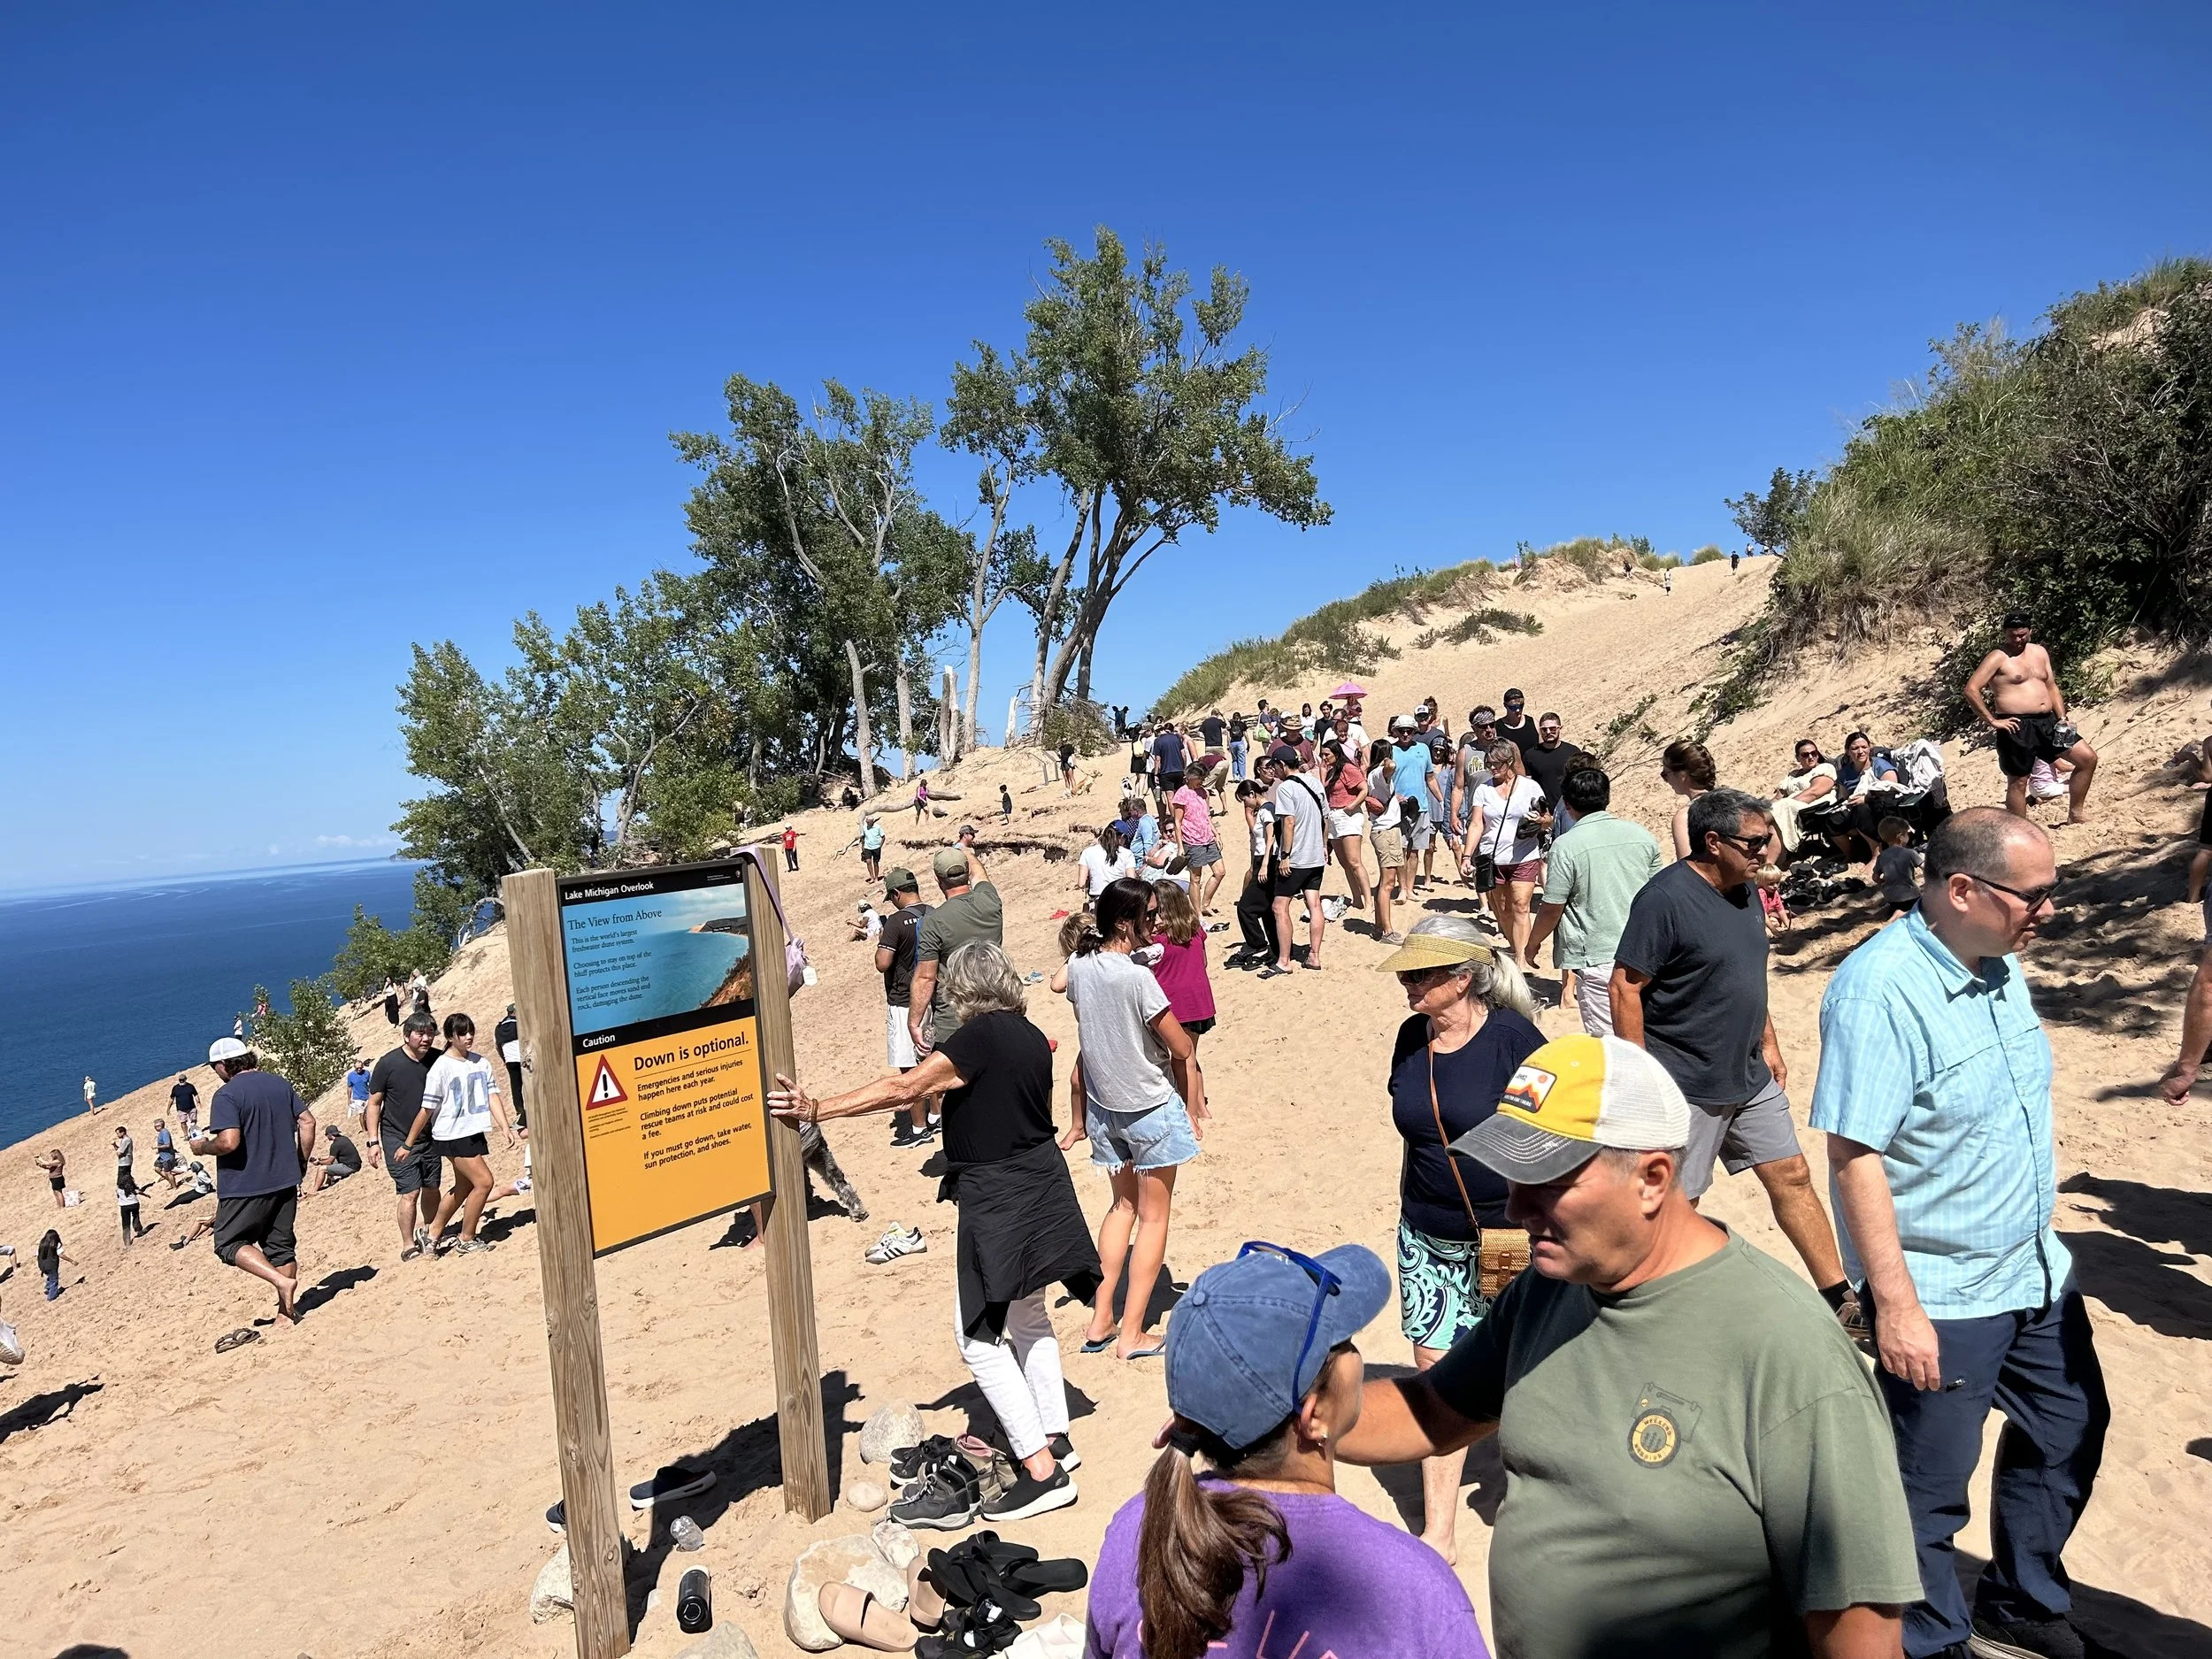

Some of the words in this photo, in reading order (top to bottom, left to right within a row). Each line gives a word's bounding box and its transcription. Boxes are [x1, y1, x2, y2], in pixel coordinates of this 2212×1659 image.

[565, 890, 583, 900] Lake
[585, 887, 618, 897] Michigan
[620, 881, 654, 893] Overlook
[567, 919, 586, 930] The
[588, 917, 611, 926] View
[612, 914, 634, 924] from
[635, 910, 662, 920] Above
[573, 960, 600, 969] Choosing
[588, 966, 611, 977] protects
[622, 962, 637, 971] place.
[590, 983, 609, 992] person
[610, 978, 641, 987] descending
[592, 997, 618, 1007] damaging
[582, 1034, 616, 1048] Caution
[634, 1051, 675, 1071] Down
[679, 1046, 689, 1060] is
[693, 1031, 749, 1058] optional.
[637, 1074, 680, 1092] Emergencies
[681, 1070, 695, 1080] and
[695, 1064, 718, 1077] serious
[720, 1059, 743, 1071] injuries
[448, 1071, 489, 1119] 10
[638, 1088, 664, 1101] happen
[665, 1082, 681, 1094] here
[683, 1079, 698, 1090] each
[700, 1076, 715, 1087] year.
[640, 1108, 671, 1121] Climbing
[672, 1102, 692, 1112] down
[694, 1096, 708, 1108] puts
[709, 1087, 738, 1103] potential
[641, 1119, 663, 1131] rescue
[664, 1112, 686, 1124] teams
[695, 1106, 708, 1116] risk
[709, 1102, 721, 1111] and
[722, 1096, 740, 1108] could
[741, 1093, 754, 1102] cost
[643, 1151, 649, 1160] If
[650, 1148, 664, 1160] you
[665, 1142, 683, 1153] must
[684, 1140, 694, 1149] go
[695, 1133, 716, 1144] down,
[718, 1128, 732, 1138] take
[733, 1122, 752, 1133] water,
[644, 1160, 657, 1169] sun
[658, 1149, 695, 1166] protection,
[697, 1143, 710, 1153] and
[710, 1138, 732, 1149] shoes.
